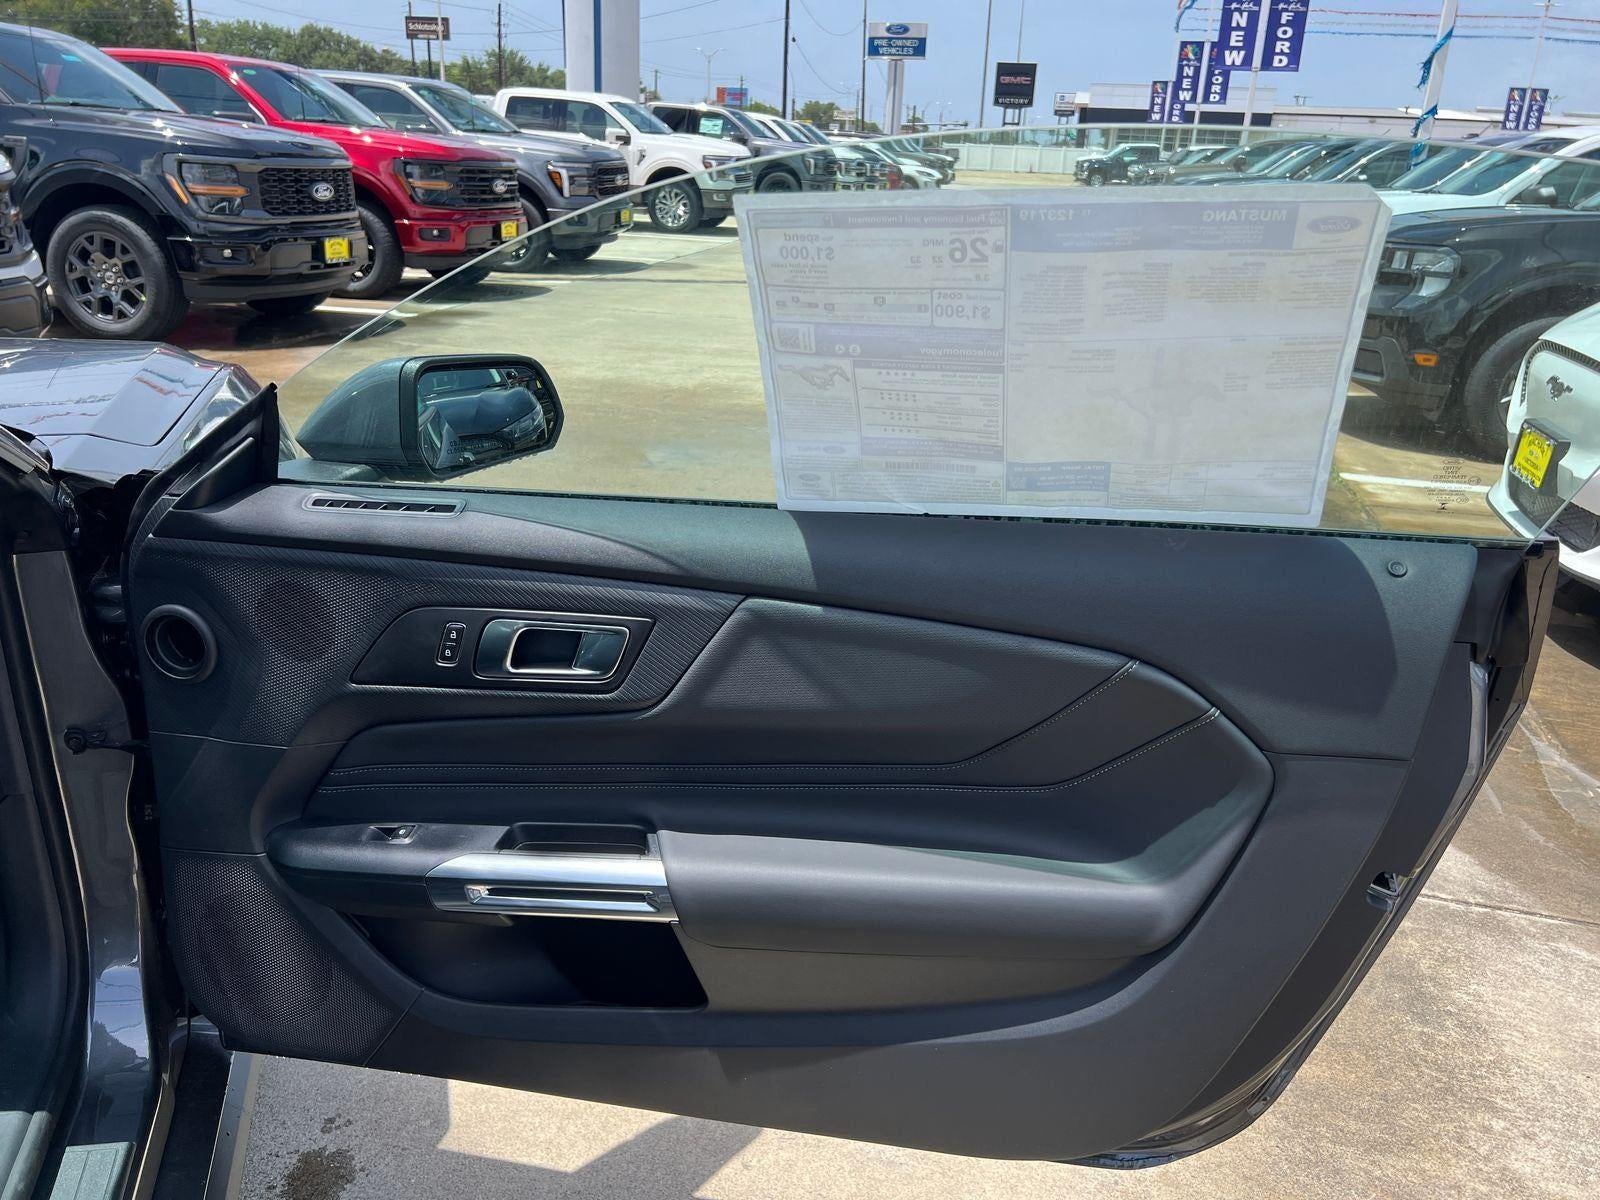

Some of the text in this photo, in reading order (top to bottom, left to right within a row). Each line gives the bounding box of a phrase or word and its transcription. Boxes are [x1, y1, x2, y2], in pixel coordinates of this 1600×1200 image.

[1224, 12, 1248, 66] NEW
[1272, 12, 1294, 67] FORD
[1000, 76, 1032, 84] GMC
[1178, 66, 1194, 100] NEW
[1151, 97, 1162, 120] NEW
